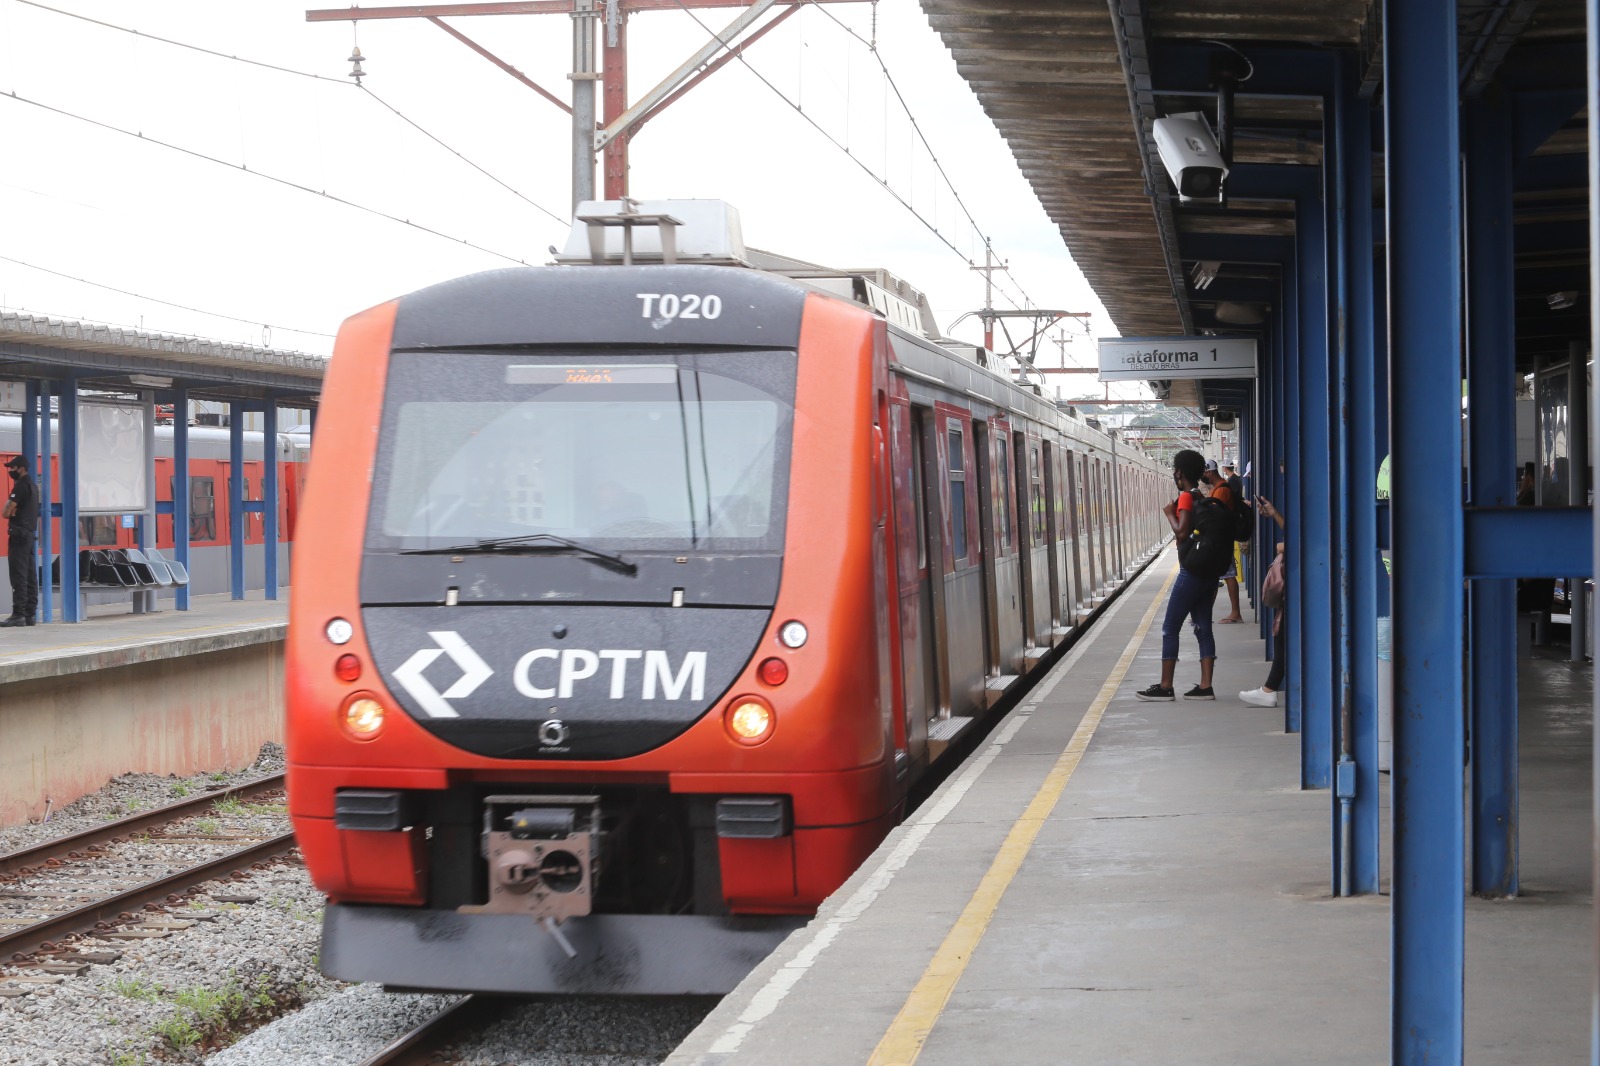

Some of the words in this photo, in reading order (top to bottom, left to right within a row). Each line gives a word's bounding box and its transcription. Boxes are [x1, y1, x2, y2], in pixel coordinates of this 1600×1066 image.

[637, 293, 722, 319] T020
[1210, 348, 1217, 361] 1
[1131, 362, 1160, 370] DESTINO
[513, 648, 708, 700] CPTM
